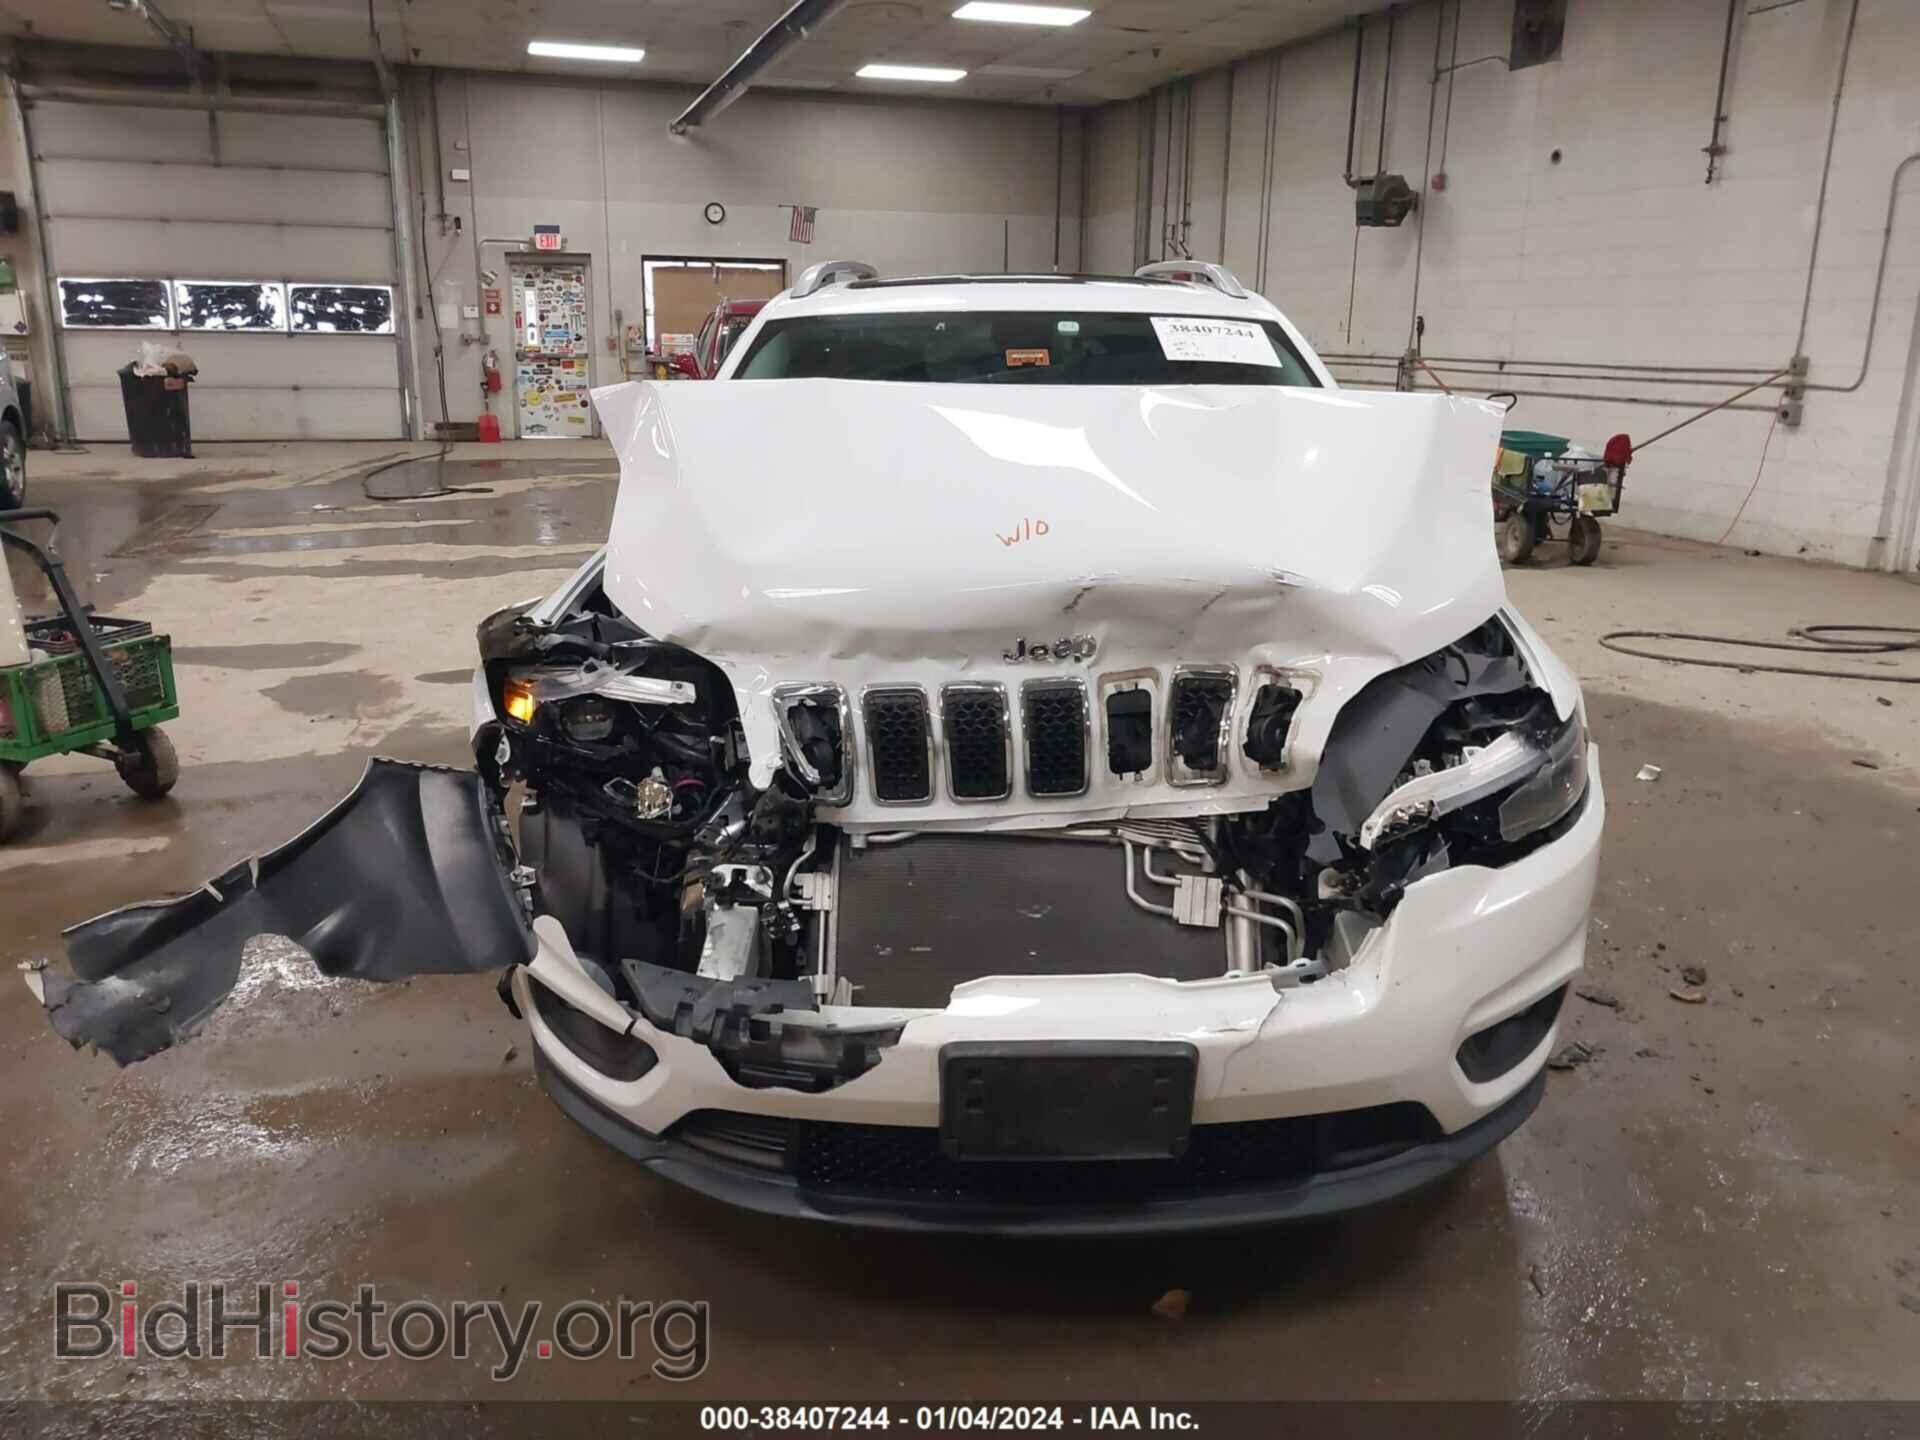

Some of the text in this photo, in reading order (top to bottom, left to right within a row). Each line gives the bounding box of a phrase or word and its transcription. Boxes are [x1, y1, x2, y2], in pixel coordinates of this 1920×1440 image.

[540, 234, 557, 248] EXIT
[1168, 324, 1255, 341] 38407244
[1003, 633, 1097, 666] Jeep
